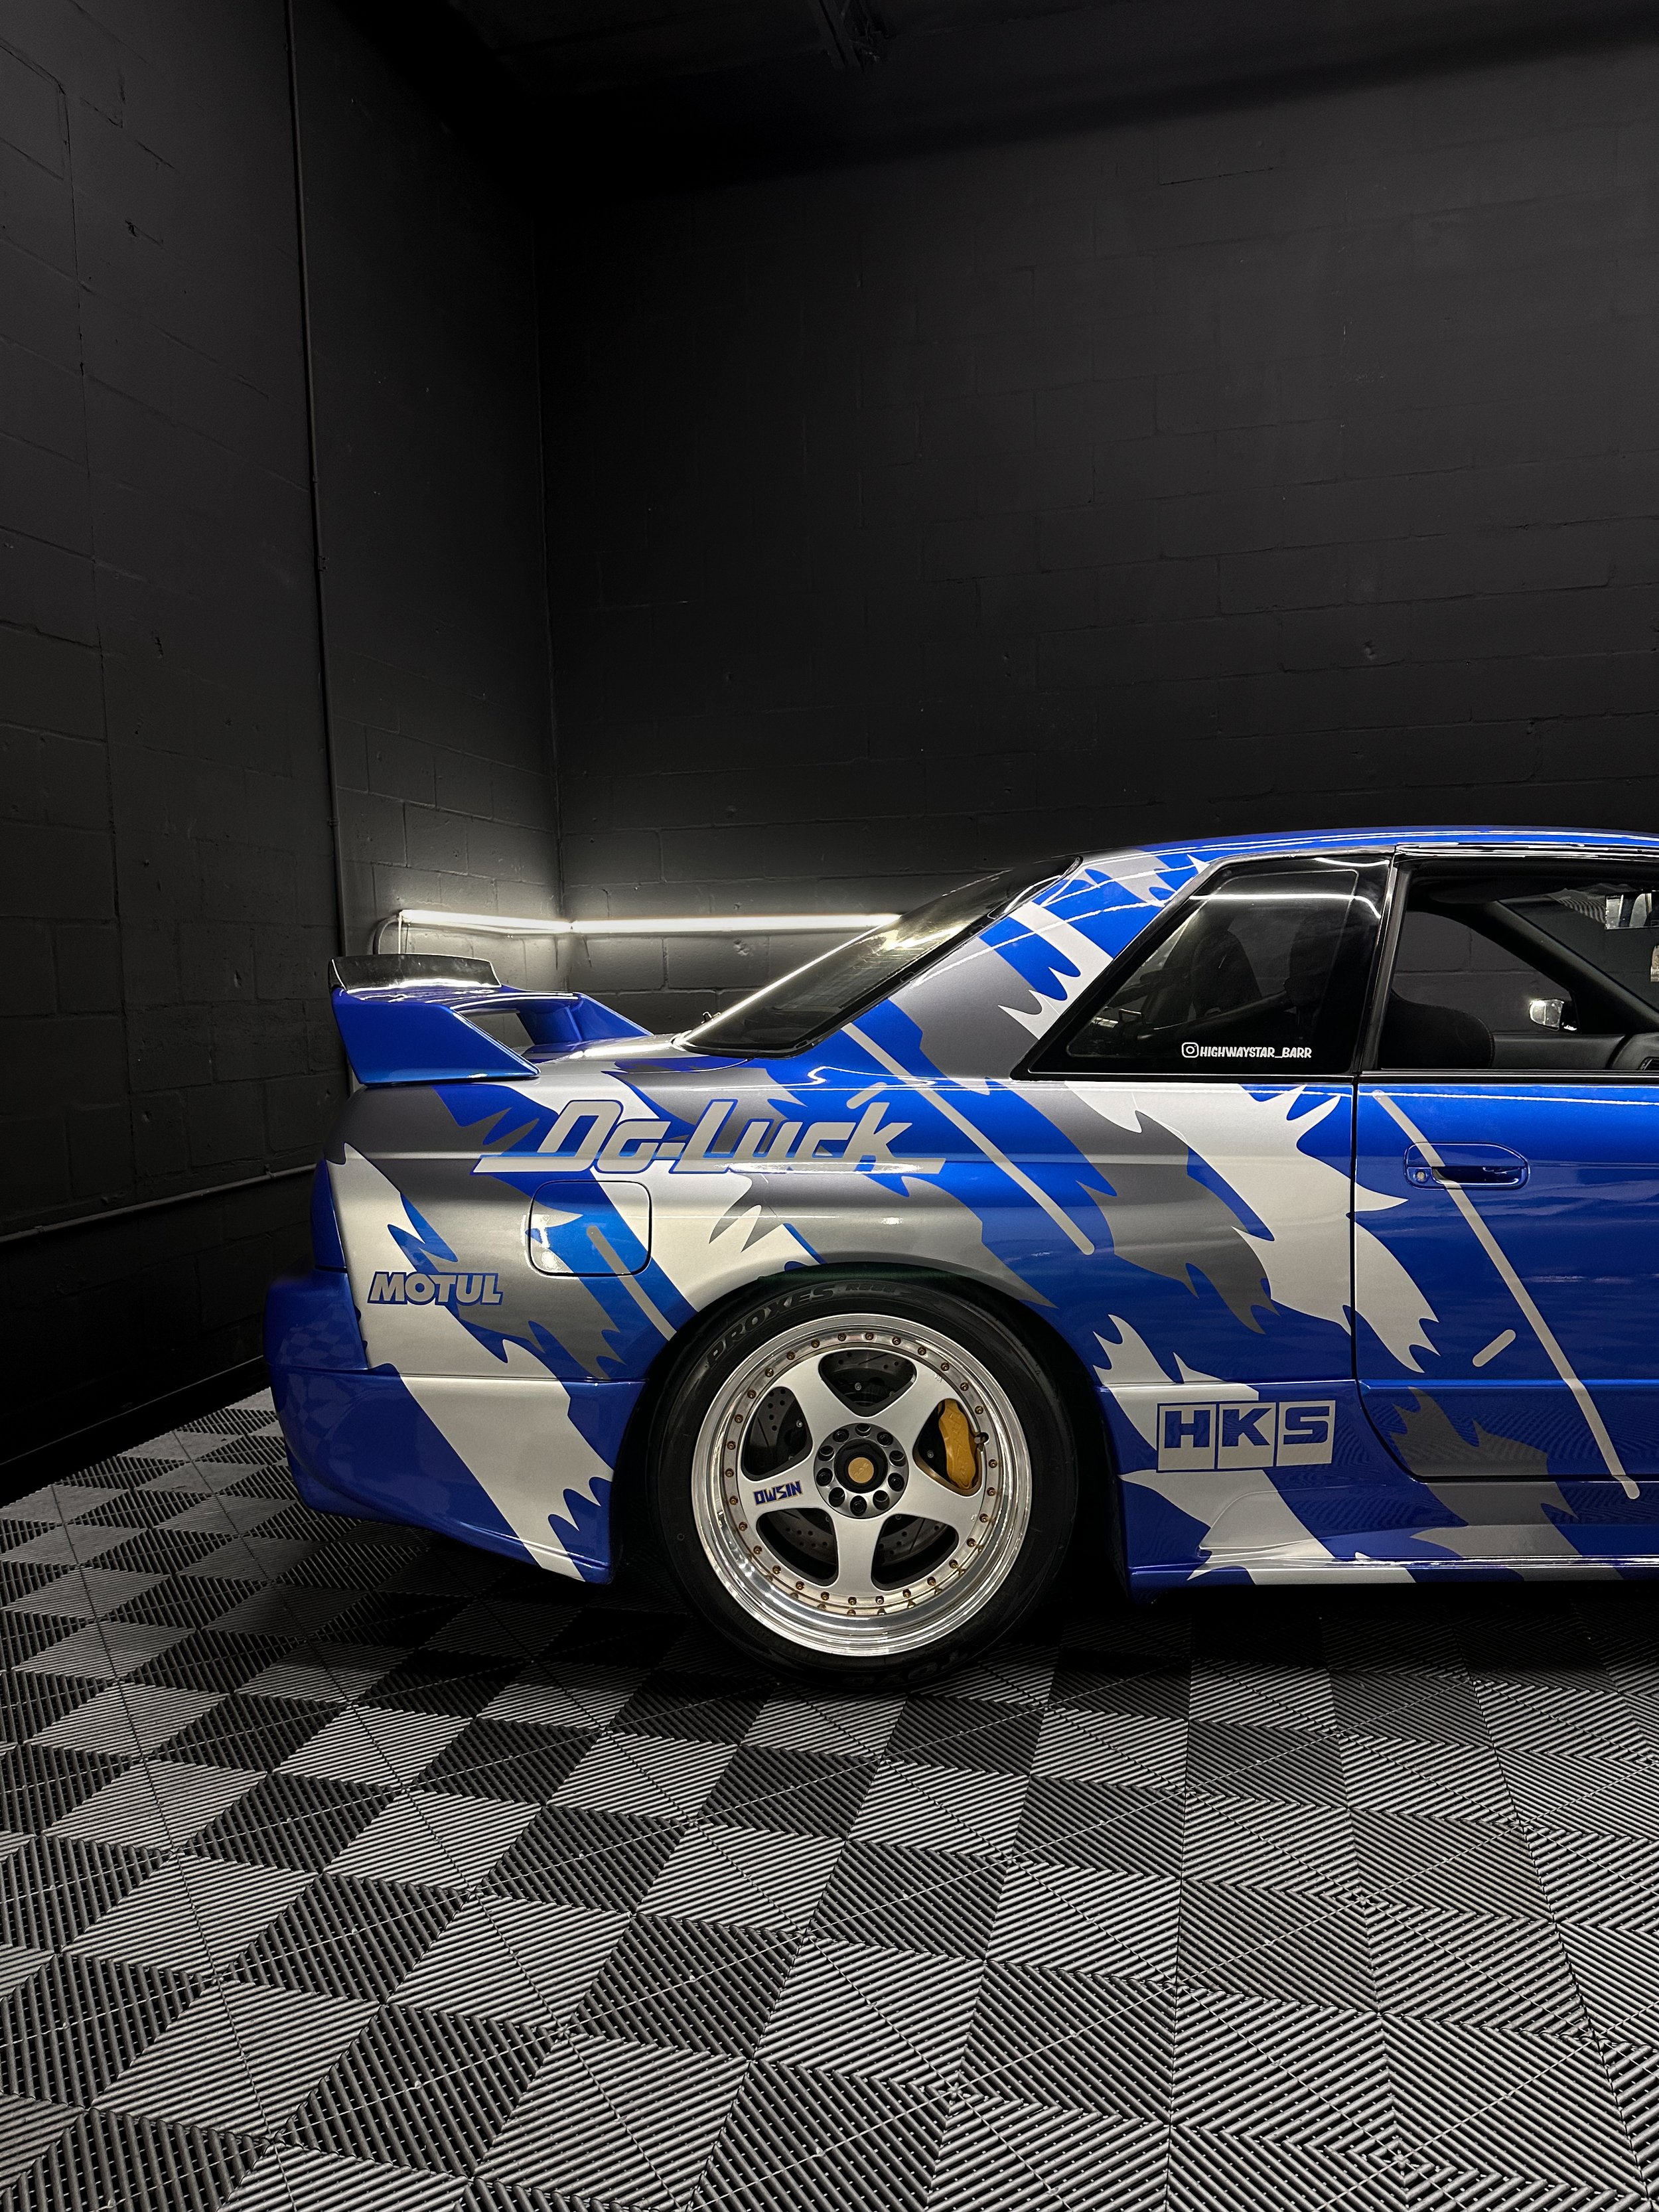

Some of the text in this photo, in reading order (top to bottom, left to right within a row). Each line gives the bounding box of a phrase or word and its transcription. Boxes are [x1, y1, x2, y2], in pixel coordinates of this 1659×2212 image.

[1199, 1046, 1313, 1059] HIGHWAYSTAR_BARR
[368, 1272, 503, 1305] MOTUL
[706, 1284, 836, 1366] PROXES
[1163, 1404, 1331, 1449] HKS
